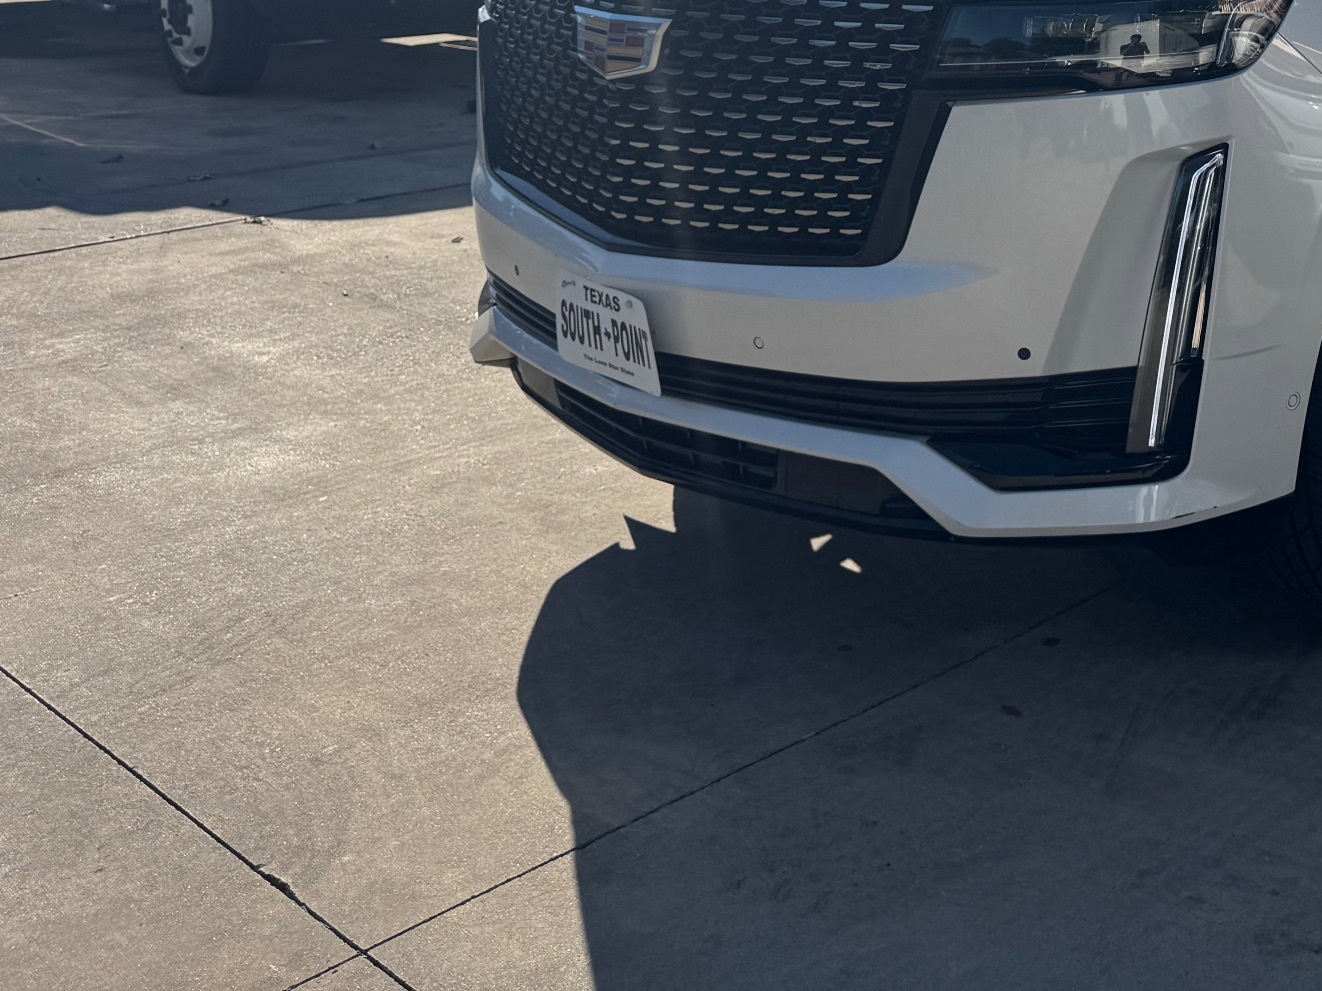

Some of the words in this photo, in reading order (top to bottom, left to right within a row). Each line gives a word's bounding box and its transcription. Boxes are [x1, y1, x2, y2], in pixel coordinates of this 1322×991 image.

[583, 285, 621, 312] TEXAS
[561, 299, 604, 352] SOUTH
[611, 318, 652, 370] POINT
